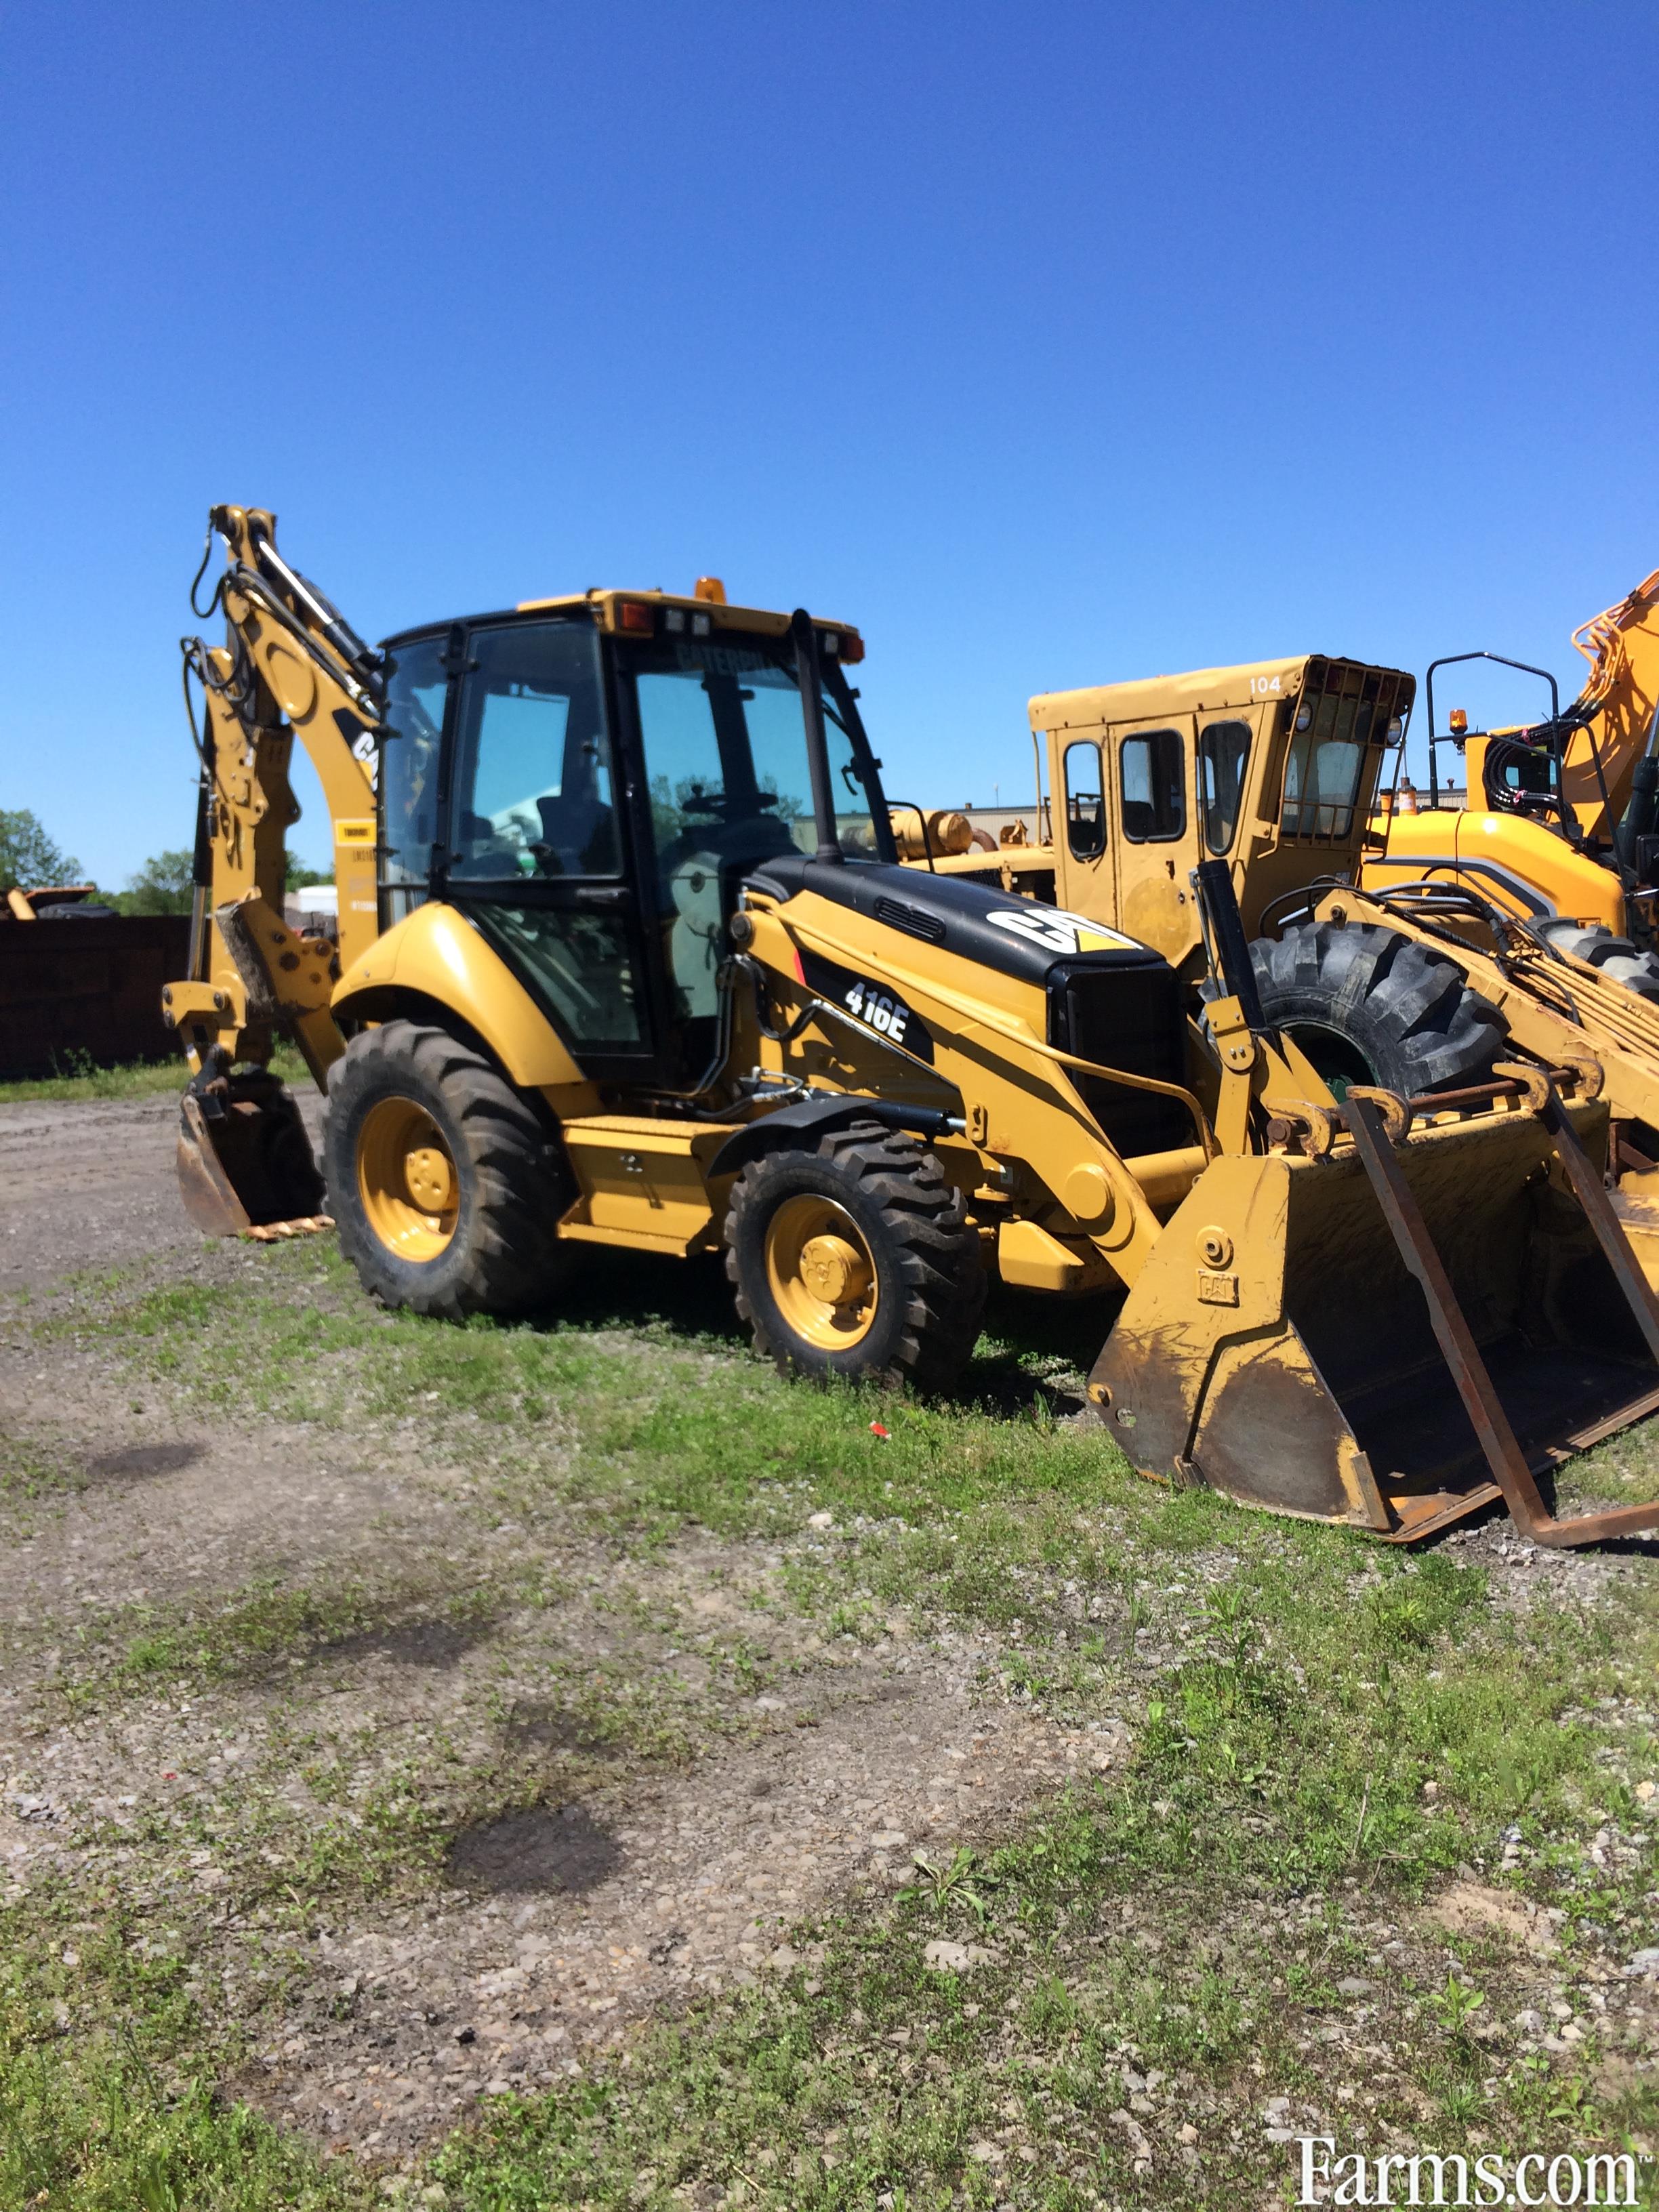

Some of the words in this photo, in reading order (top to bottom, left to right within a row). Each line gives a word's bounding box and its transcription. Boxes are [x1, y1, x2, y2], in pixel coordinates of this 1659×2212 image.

[1250, 676, 1281, 694] 104
[986, 909, 1144, 954] CAT
[845, 982, 909, 1042] 416E
[1200, 1275, 1234, 1300] CAT
